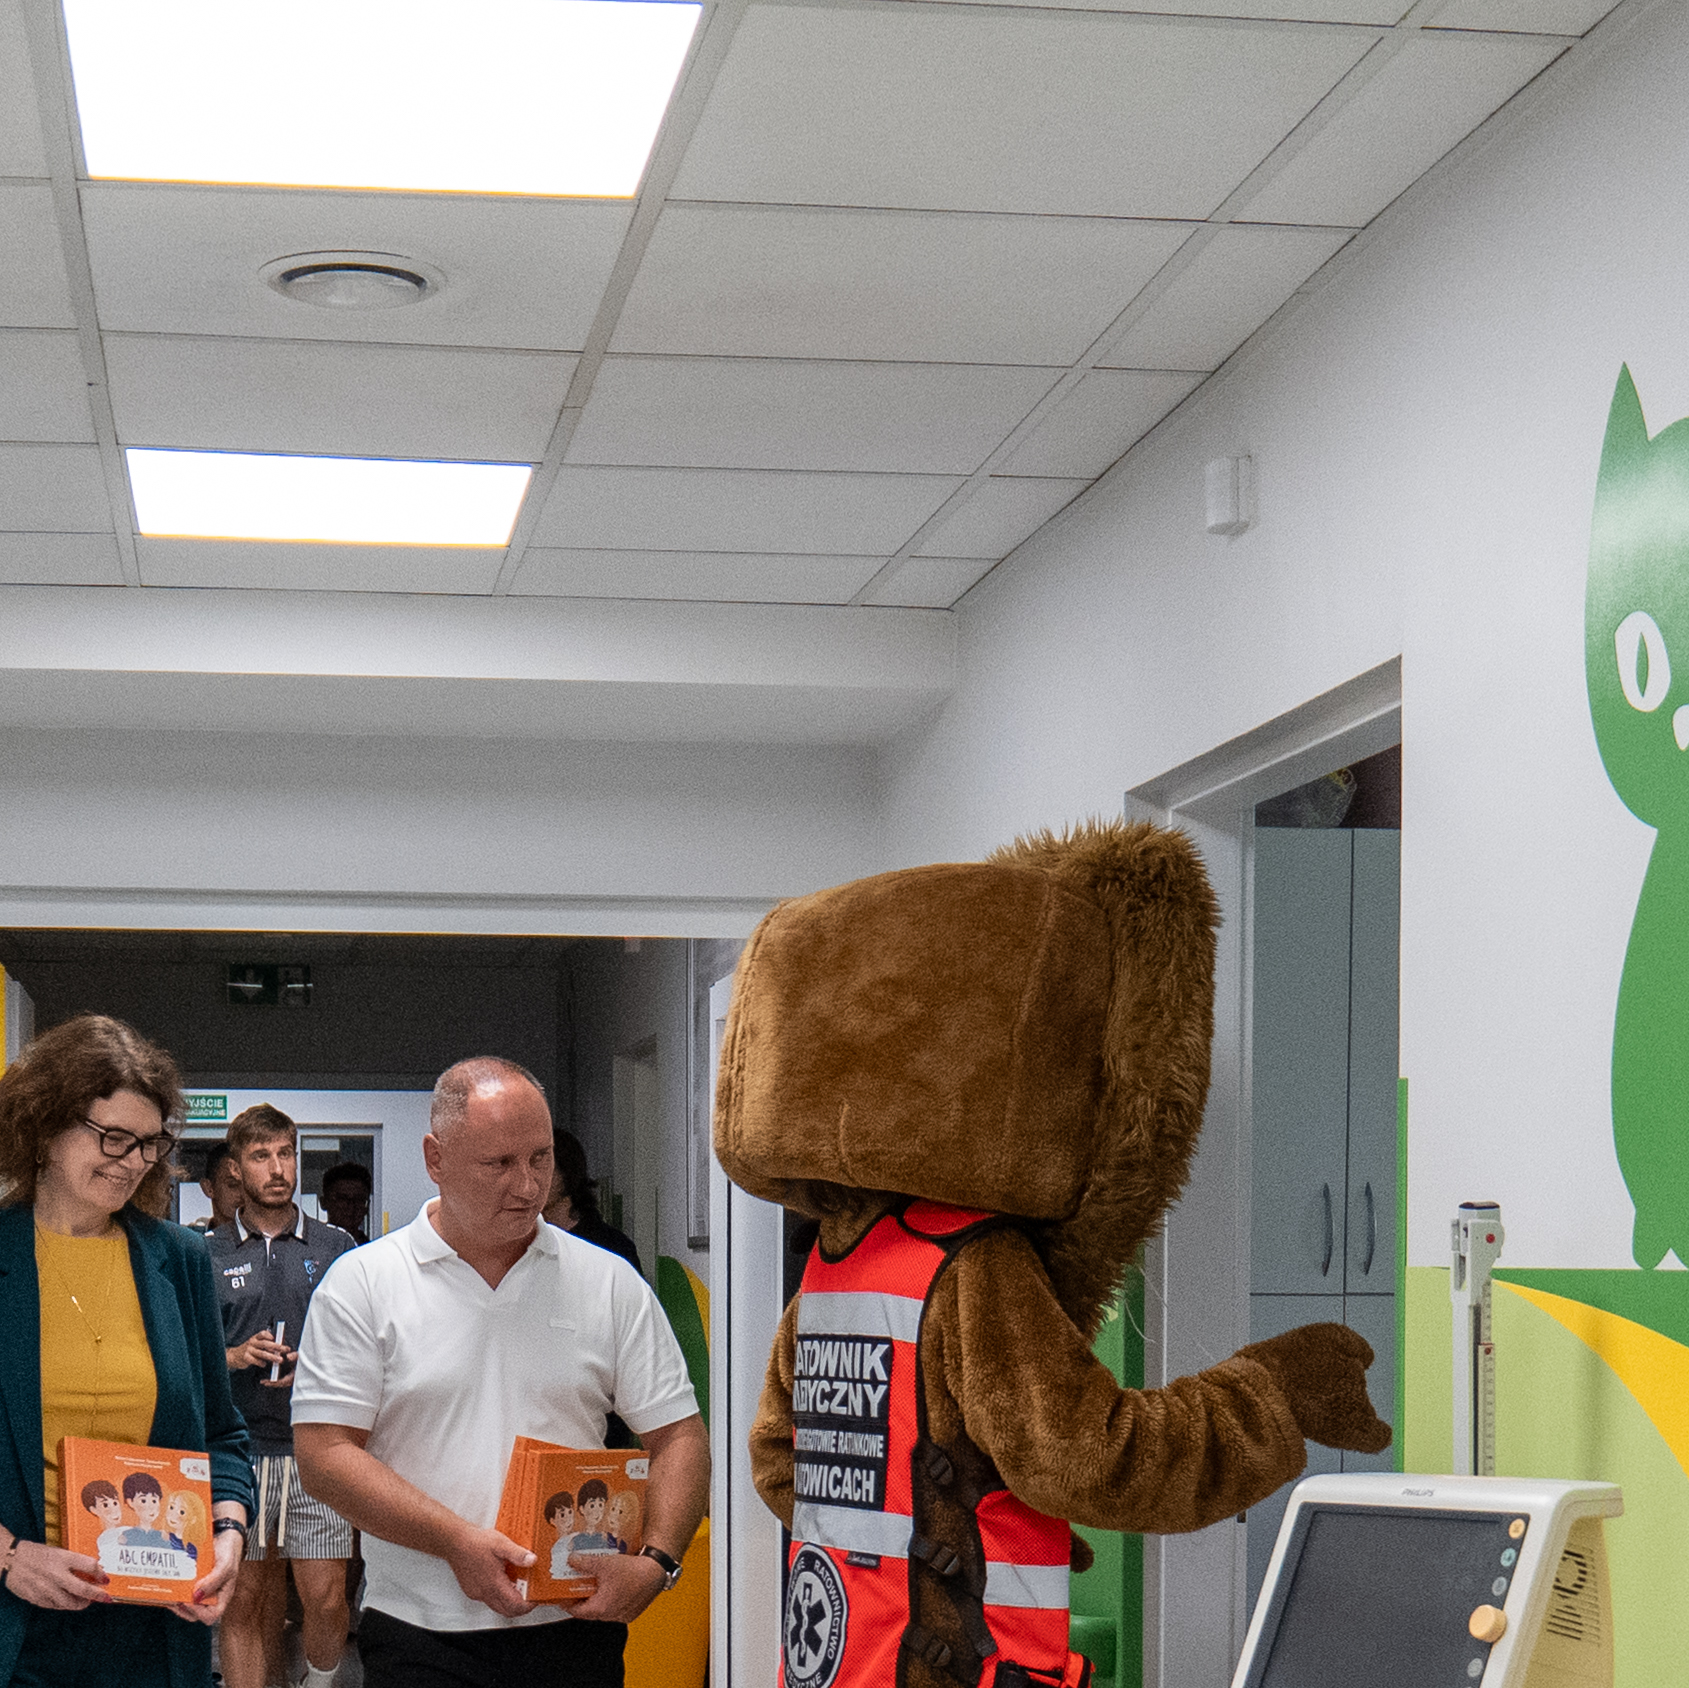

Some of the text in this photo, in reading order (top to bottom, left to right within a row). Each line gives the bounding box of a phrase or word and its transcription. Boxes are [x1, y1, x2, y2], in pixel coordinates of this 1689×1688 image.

[231, 1276, 245, 1289] 61
[794, 1340, 889, 1381] ATOWNIK
[794, 1462, 875, 1503] OWICACH
[119, 1549, 138, 1566] ABC
[813, 1559, 842, 1660] RATOWNICTWO
